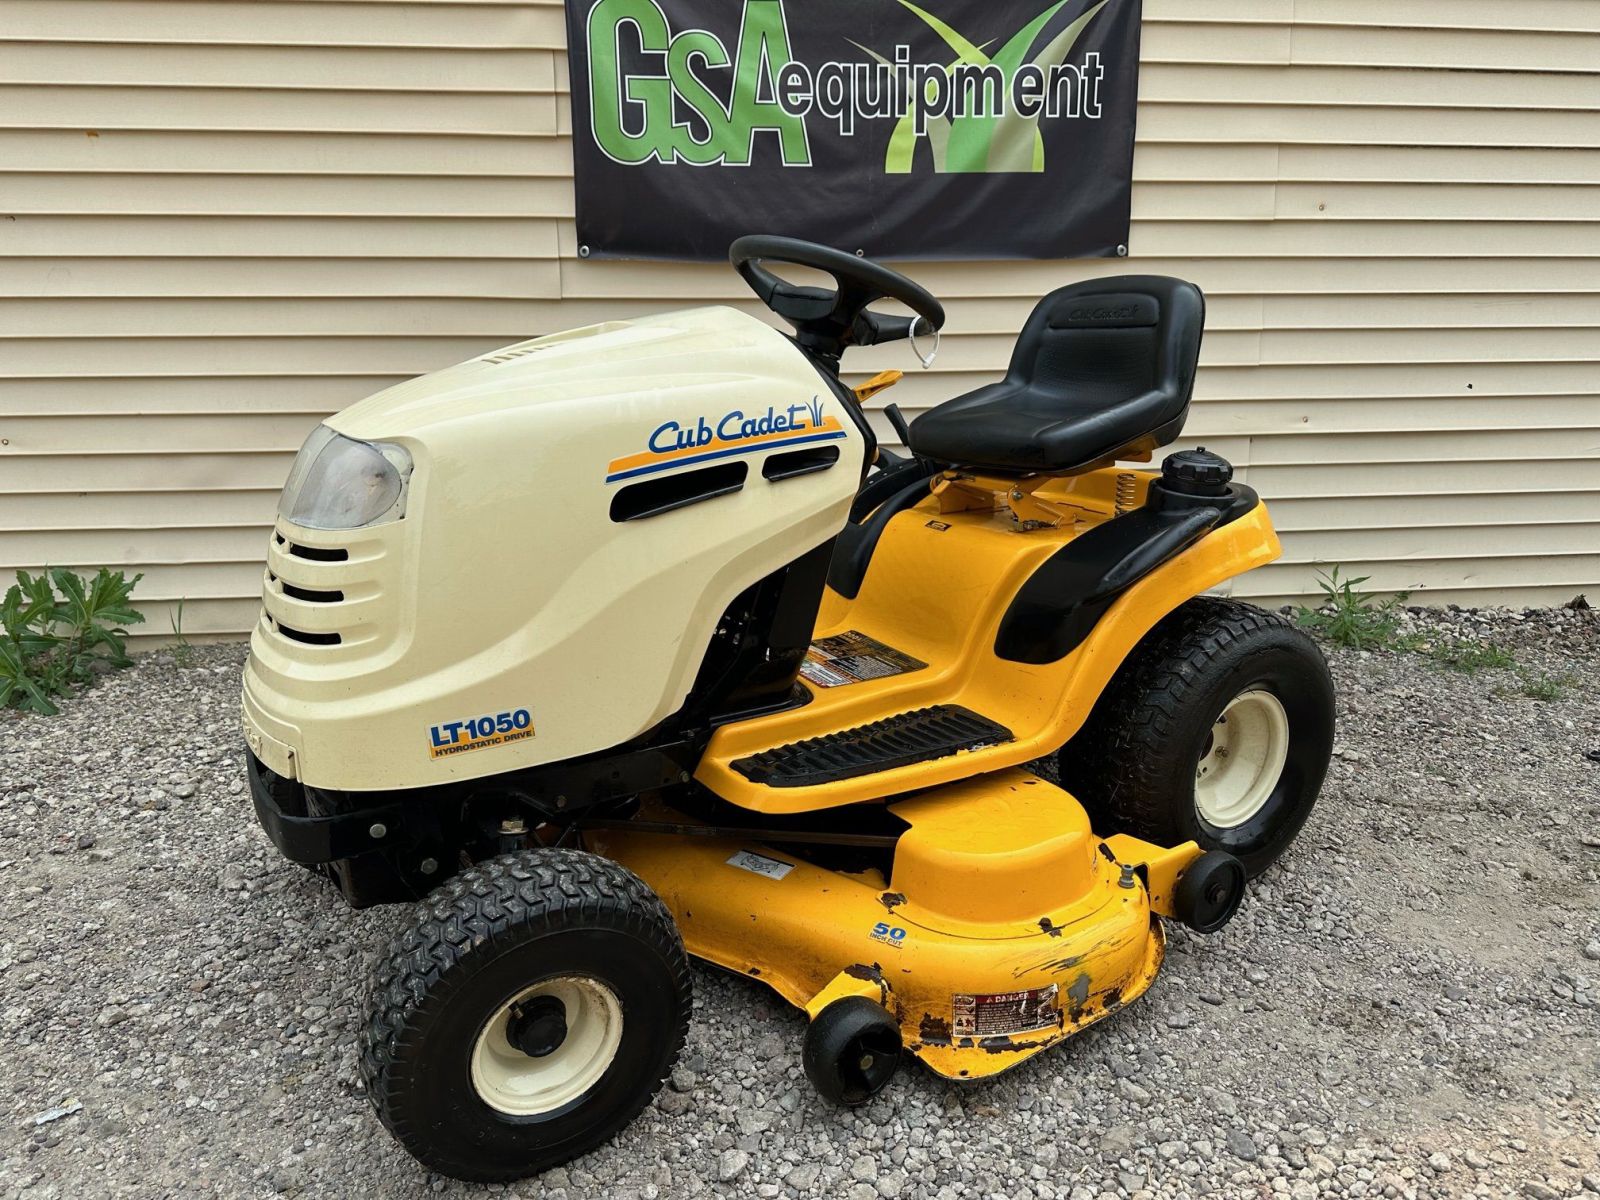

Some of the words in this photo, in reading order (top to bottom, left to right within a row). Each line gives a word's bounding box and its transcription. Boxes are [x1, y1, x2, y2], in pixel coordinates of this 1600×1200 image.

[649, 417, 713, 454] Cub
[716, 404, 806, 441] Cadet
[430, 709, 531, 747] LT1050
[435, 737, 502, 757] HYDROSTATIC
[503, 730, 533, 743] DRIVE
[873, 922, 906, 940] 50
